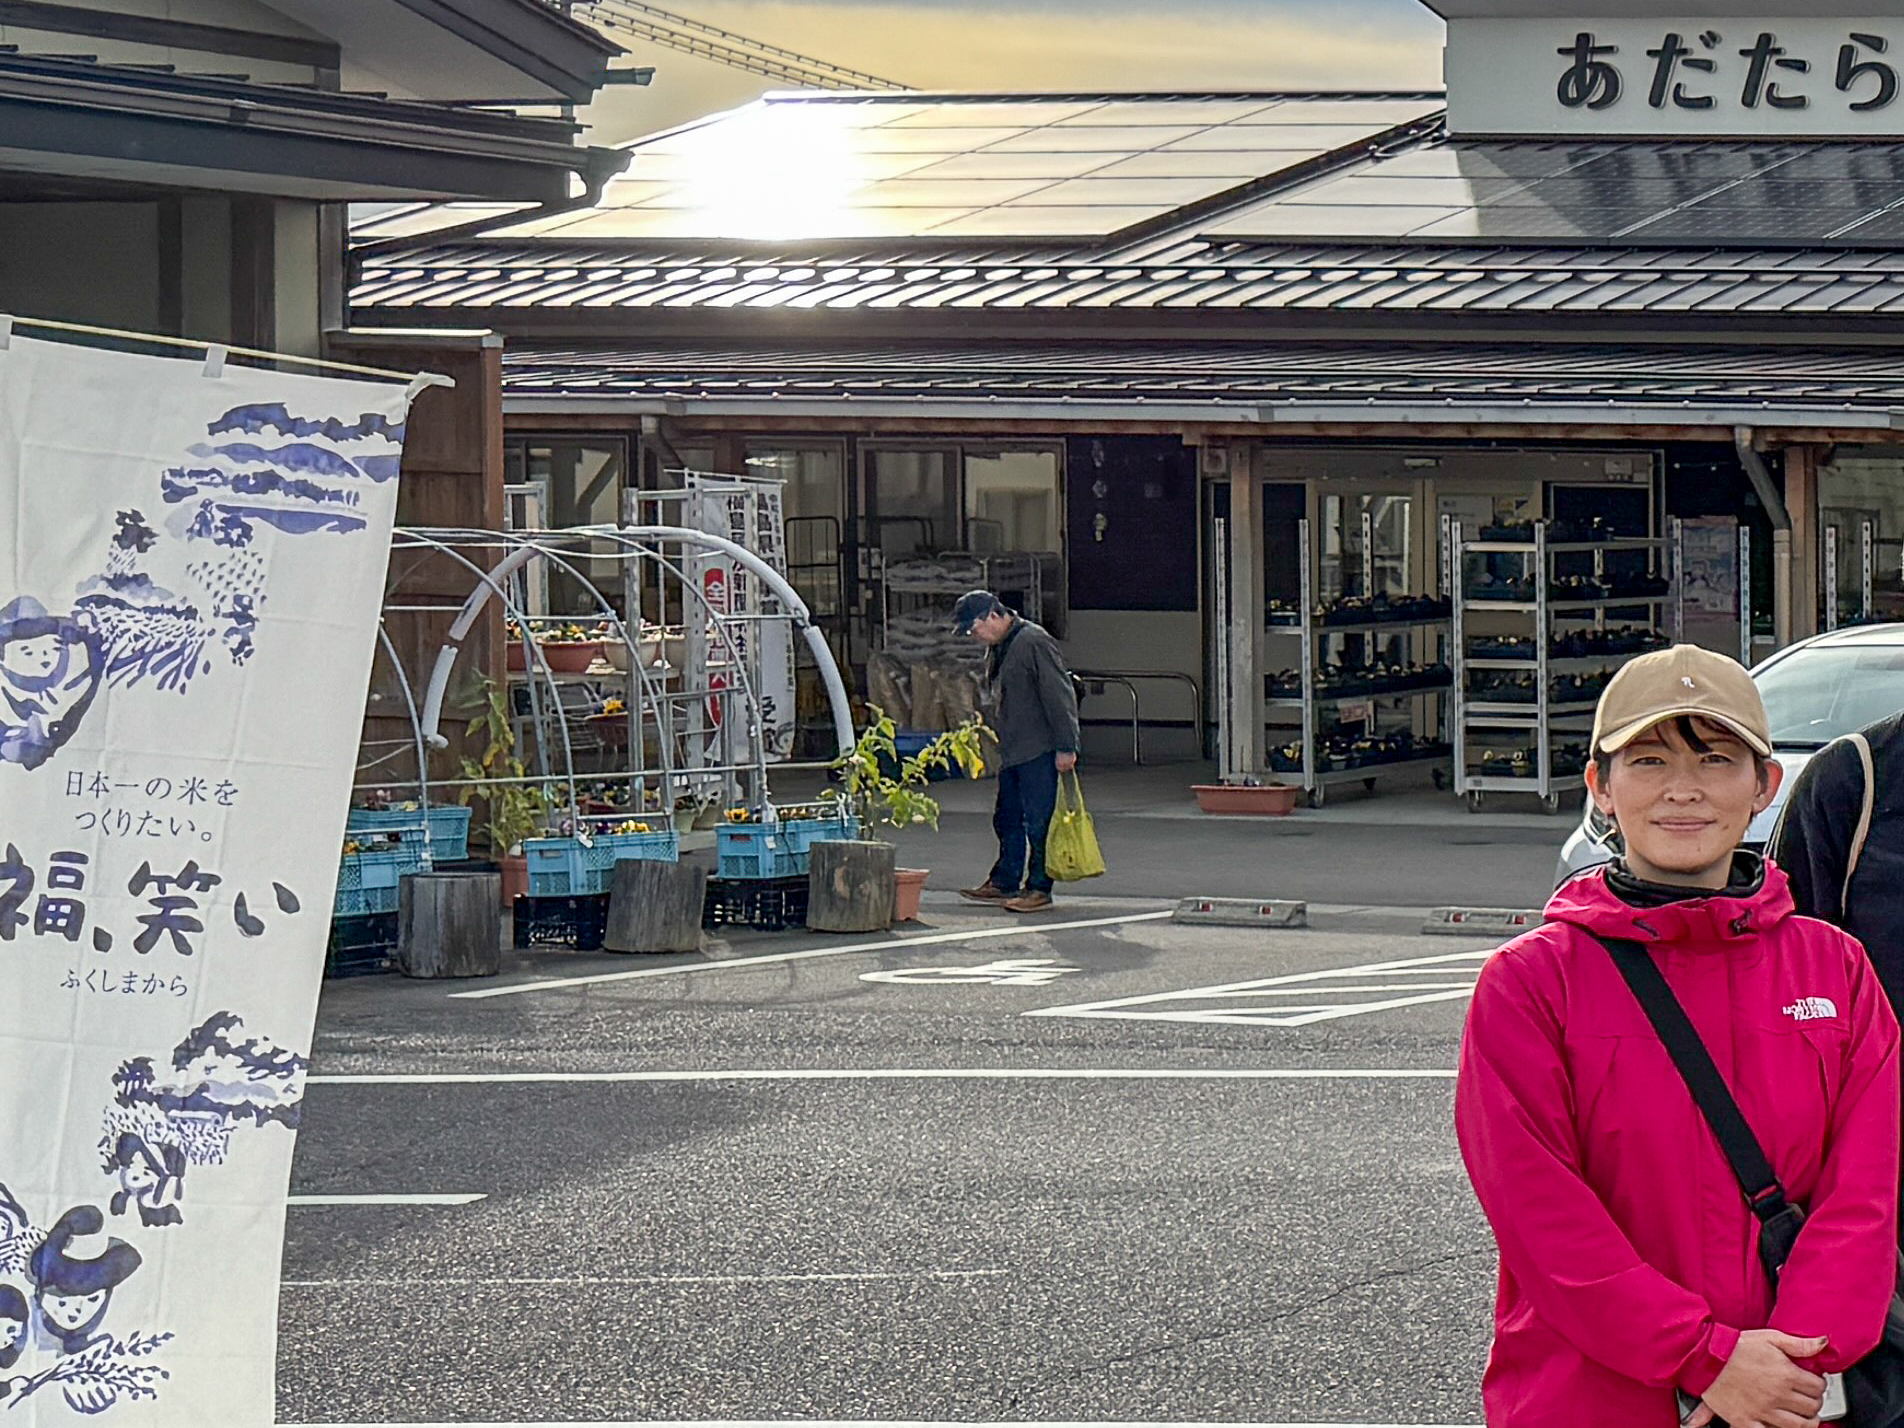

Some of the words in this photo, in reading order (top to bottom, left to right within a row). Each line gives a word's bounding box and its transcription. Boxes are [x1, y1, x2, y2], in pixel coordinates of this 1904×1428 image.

[66, 770, 240, 807] 日本一の米を
[74, 807, 213, 842] つくりたい。
[0, 842, 301, 956] 福、笑い
[59, 968, 188, 997] ふくしまから
